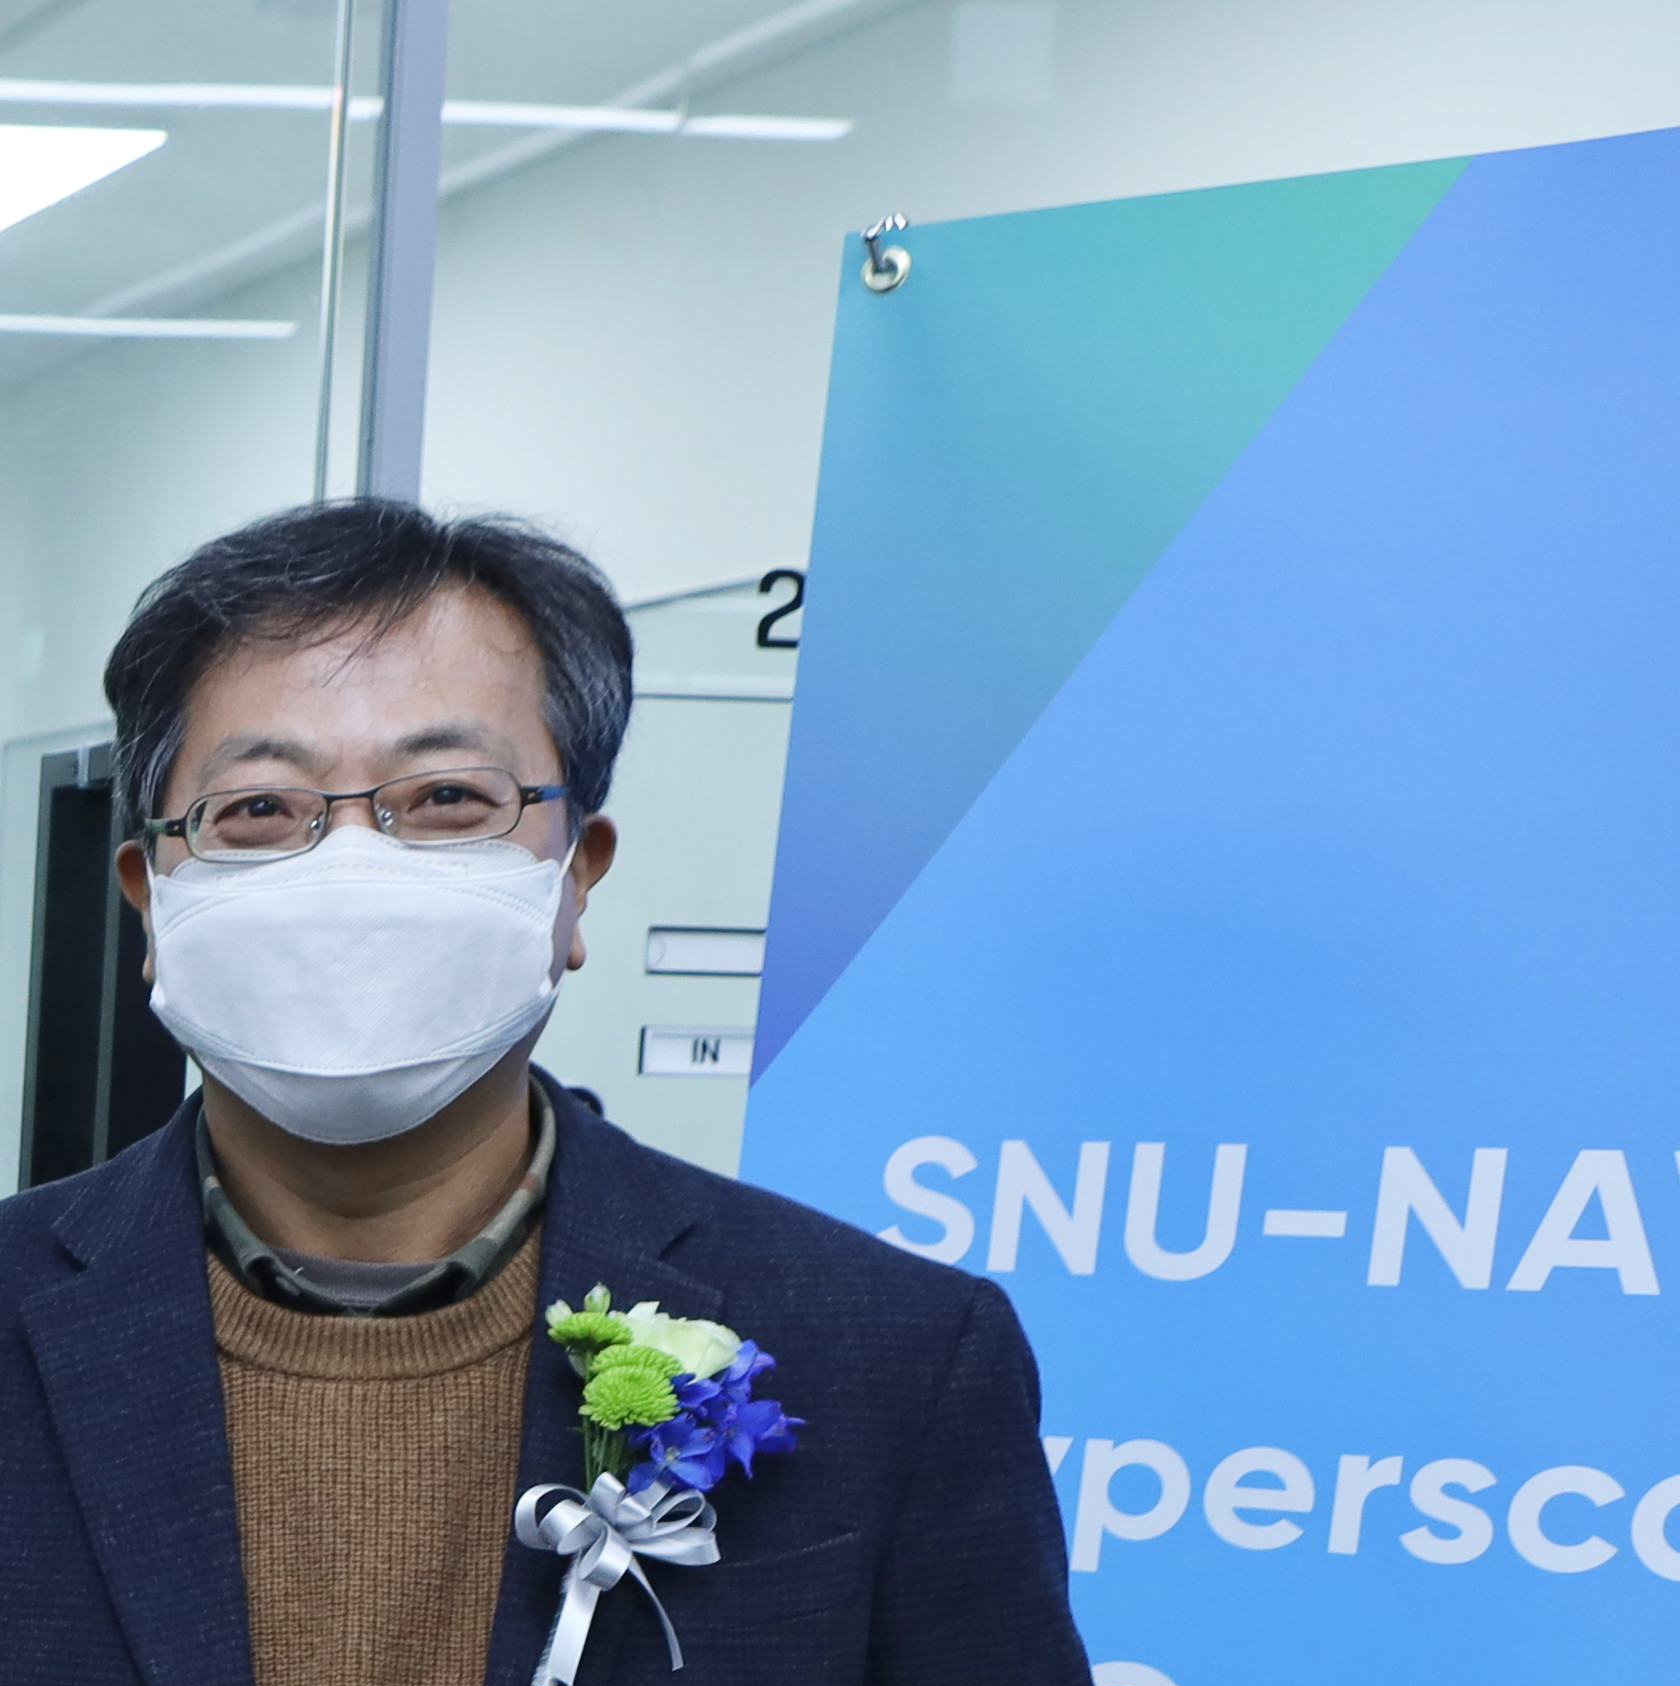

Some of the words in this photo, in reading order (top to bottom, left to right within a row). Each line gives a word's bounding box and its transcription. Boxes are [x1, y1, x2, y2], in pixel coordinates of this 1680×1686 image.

[756, 569, 805, 649] 2
[692, 1037, 721, 1063] IN
[876, 1135, 1680, 1296] SNU-NA
[1043, 1436, 1680, 1582] persc
